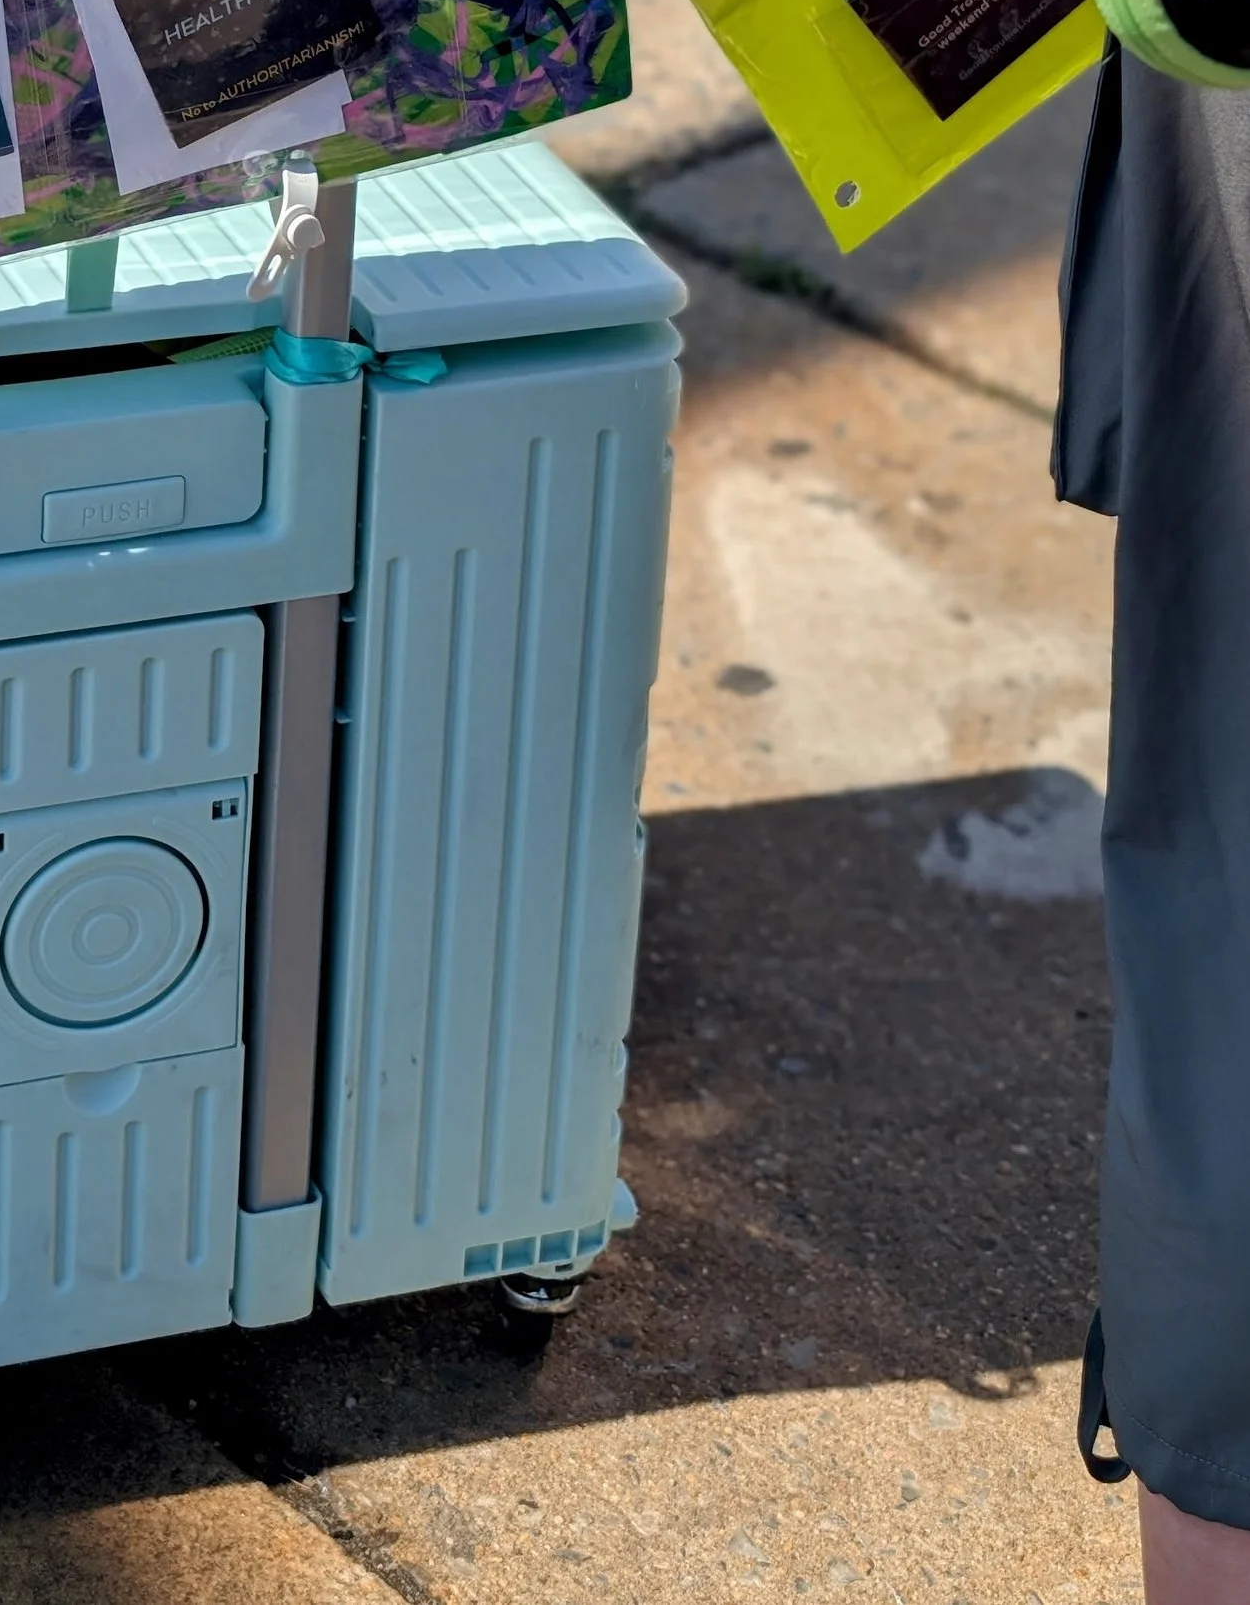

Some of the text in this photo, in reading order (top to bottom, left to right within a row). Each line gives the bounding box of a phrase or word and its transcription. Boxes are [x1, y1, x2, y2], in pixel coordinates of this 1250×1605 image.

[918, 15, 952, 48] Good
[937, 0, 990, 50] weekend
[181, 21, 365, 122] No to AUTHORITARIANISM!
[81, 499, 151, 527] PUSH
